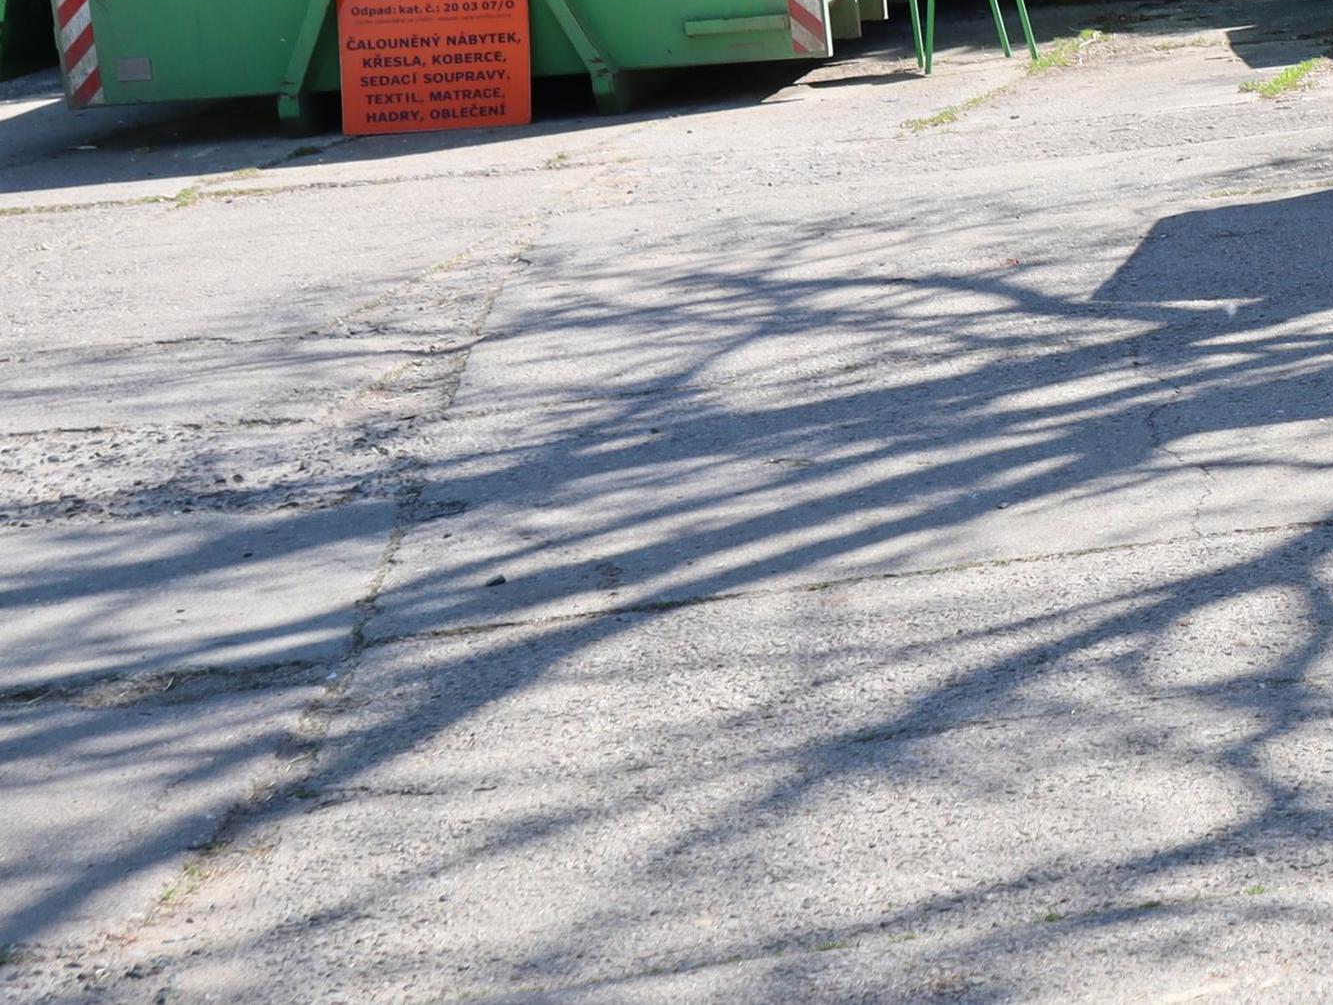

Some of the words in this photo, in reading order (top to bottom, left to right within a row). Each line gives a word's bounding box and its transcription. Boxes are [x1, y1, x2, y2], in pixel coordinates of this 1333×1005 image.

[351, 5, 397, 17] Odpad:
[399, 4, 422, 15] kat.
[443, 2, 459, 12] 20
[462, 1, 478, 11] 03
[346, 34, 441, 51] ČALOUNĚNÝ
[446, 32, 521, 47] NÁBYTEK,
[362, 54, 426, 69] KŘESLA,
[432, 51, 507, 65] KOBERCE,
[360, 73, 417, 87] SEDACÍ
[365, 109, 425, 123] HADRY,
[430, 104, 507, 120] OBLEČENÍ
